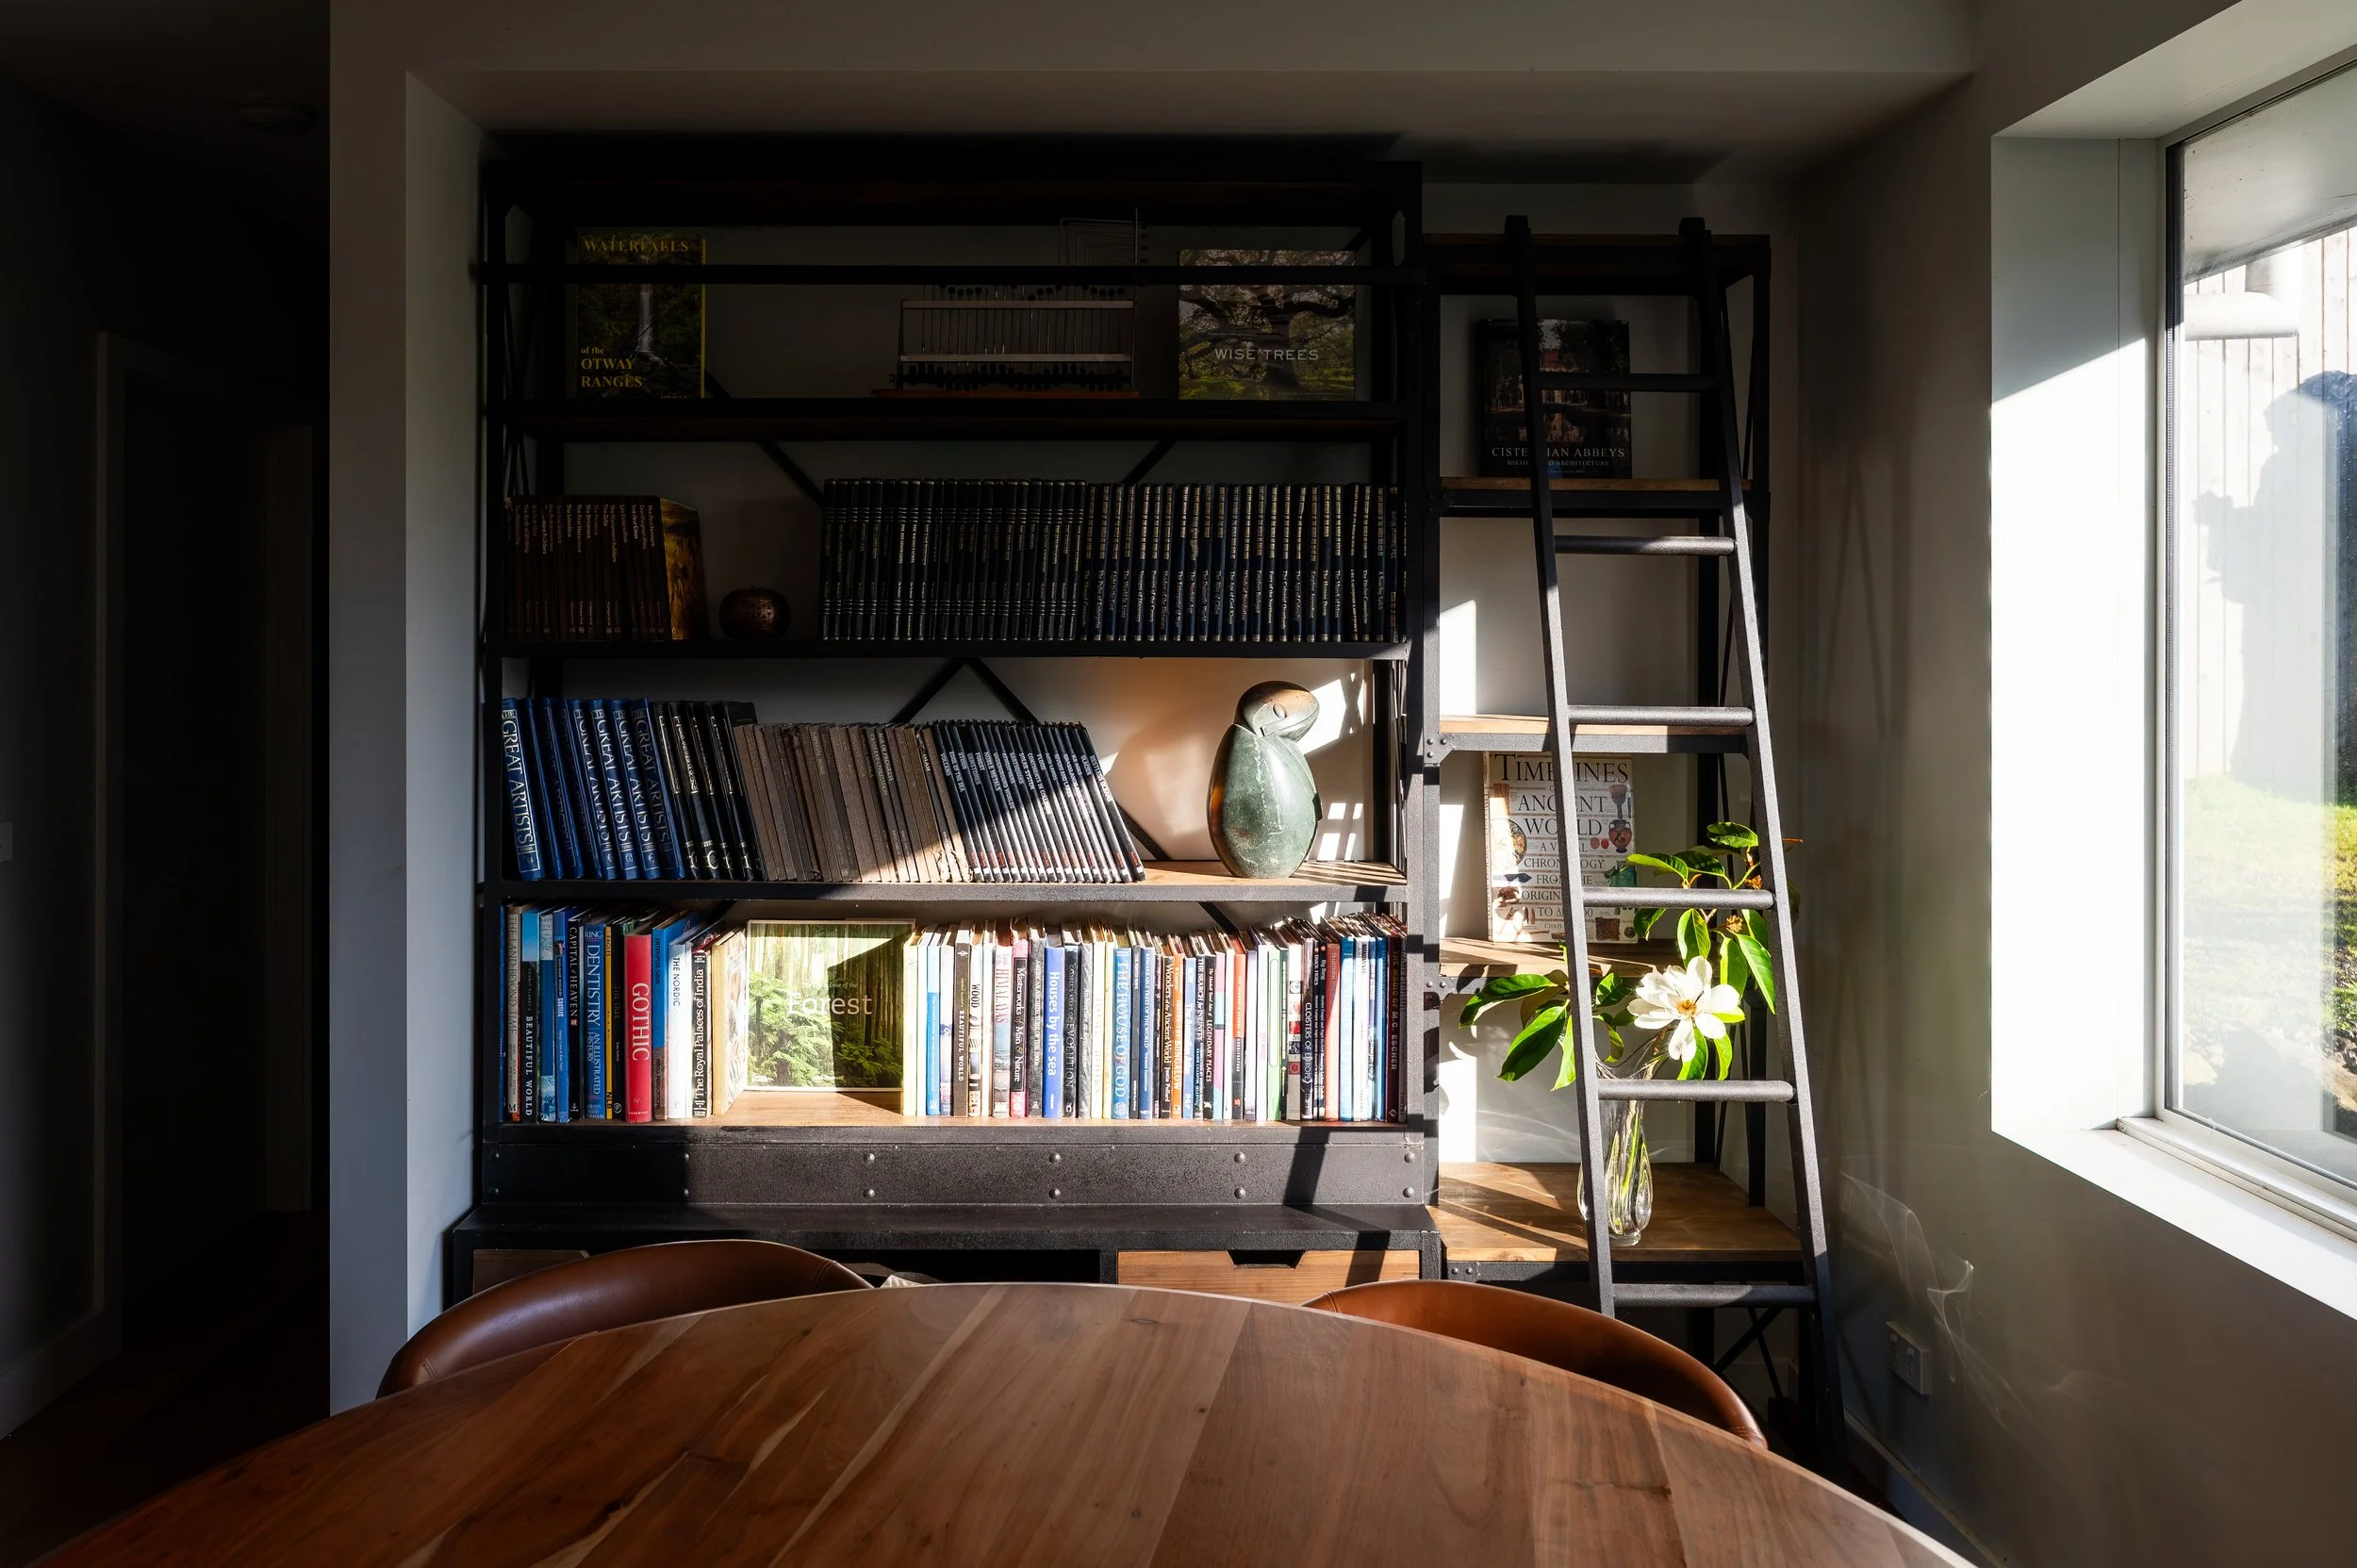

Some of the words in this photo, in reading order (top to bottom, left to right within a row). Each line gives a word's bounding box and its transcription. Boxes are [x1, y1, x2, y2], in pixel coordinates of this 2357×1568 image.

[584, 239, 689, 253] WATERFALLS
[581, 346, 589, 355] of
[590, 346, 604, 355] the
[1214, 348, 1256, 360] WISE
[1262, 349, 1319, 361] TREES
[581, 357, 635, 370] OTWAY
[581, 375, 643, 388] RANGES
[1492, 447, 1569, 457] CISTEIAN
[1574, 447, 1625, 457] ABBEYS
[502, 720, 522, 774] GREAT
[635, 719, 654, 771] GREAT
[882, 753, 894, 781] PROGRESS
[940, 753, 951, 776] VOLCANO
[967, 753, 981, 785] GEMSTONES
[984, 751, 993, 770] NOBLE
[990, 770, 1001, 792] METALS
[1009, 752, 1024, 784] EARTHQUAKE
[1019, 753, 1027, 769] SOLAR
[1025, 770, 1035, 790] SYSTEM
[1037, 754, 1046, 770] FLOOD
[1054, 754, 1063, 771] RIVERS
[1060, 772, 1068, 781] AND
[1081, 755, 1091, 776] GLACIER
[1089, 755, 1104, 781] RESTLESS
[1494, 753, 1628, 783] TIMINES
[596, 720, 613, 770] GREAT
[608, 777, 630, 842] ARTISTS
[993, 752, 1007, 788] UNDERGROUND
[1004, 788, 1015, 809] WORLDS
[509, 779, 534, 844] ARTISTS
[644, 778, 670, 843] ARTISTS
[1518, 794, 1607, 813] ANCNT
[1524, 818, 1603, 836] WOLD
[1540, 842, 1547, 851] A
[1524, 858, 1605, 869] CHROOGY
[1536, 874, 1561, 884] FRO
[1521, 889, 1562, 900] ORIGIN
[1537, 906, 1553, 917] TO
[509, 916, 517, 935] THE
[509, 939, 517, 966] LAND
[509, 969, 517, 1006] BEYOND
[695, 969, 706, 994] India
[1117, 961, 1129, 990] THE
[1165, 963, 1173, 999] Wonders
[587, 945, 600, 1026] DENTISTRY
[594, 1032, 600, 1045] AN
[694, 996, 707, 1008] of
[786, 992, 872, 1015] Forest
[971, 984, 980, 1008] WOOD
[995, 969, 1009, 1023] HIMALAYAS
[1015, 968, 1025, 1015] Masterworks
[1048, 972, 1060, 1012] Houses
[1393, 998, 1398, 1008] OF
[509, 1009, 517, 1034] TIME
[632, 983, 649, 1061] GOTHIC
[694, 1010, 707, 1049] Palaces
[1047, 1015, 1059, 1029] by
[1116, 995, 1129, 1042] HOUSE
[1164, 1011, 1173, 1040] Ancient
[1048, 1033, 1059, 1053] the
[1066, 1023, 1075, 1087] EVOLUTION
[1116, 1045, 1128, 1062] OF
[1164, 1041, 1172, 1063] World
[1305, 1040, 1312, 1050] OF
[693, 1050, 707, 1076] Royal
[1048, 1056, 1056, 1075] sea
[1173, 1040, 1182, 1090] BUNGALOW
[694, 1078, 707, 1097] The
[1115, 1065, 1127, 1097] GOD
